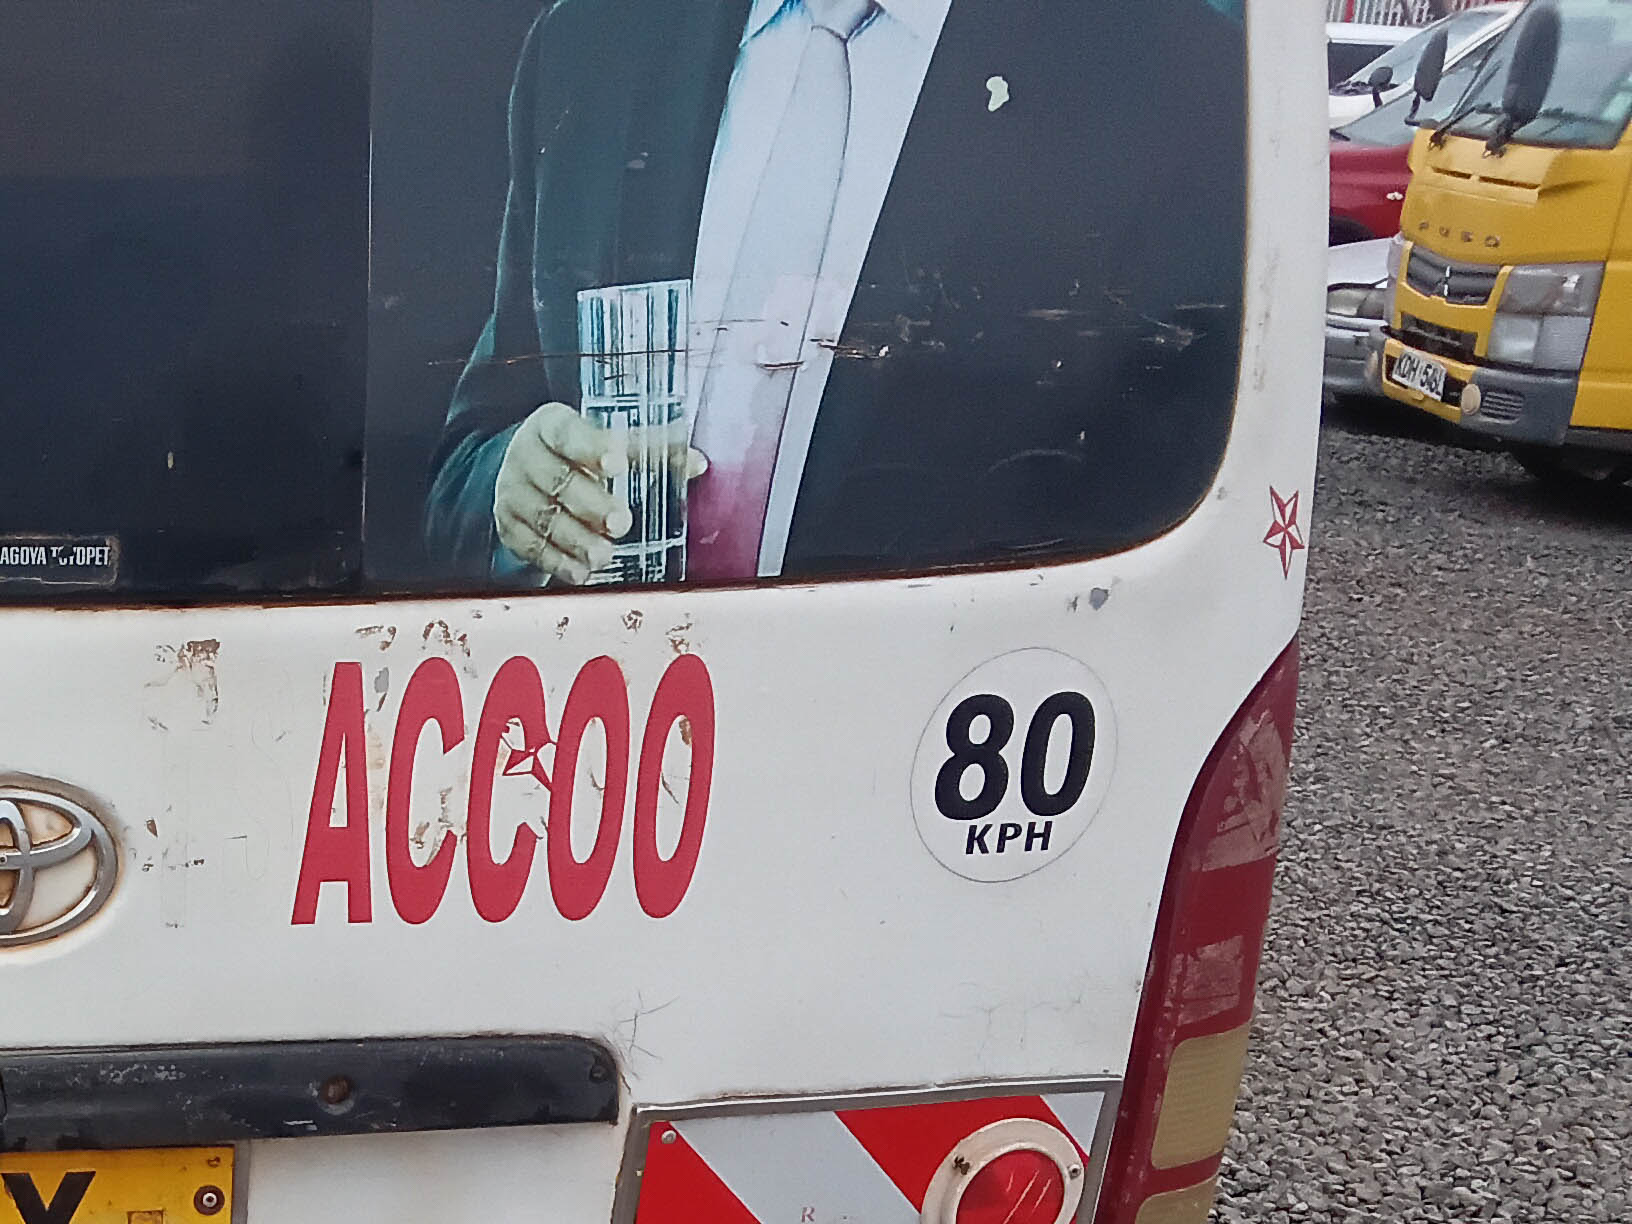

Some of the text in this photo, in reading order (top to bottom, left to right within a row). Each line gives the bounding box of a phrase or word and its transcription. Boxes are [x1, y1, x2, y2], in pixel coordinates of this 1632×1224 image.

[290, 653, 716, 926] ACCOO
[933, 690, 1096, 821] 80
[965, 820, 1053, 855] KPH
